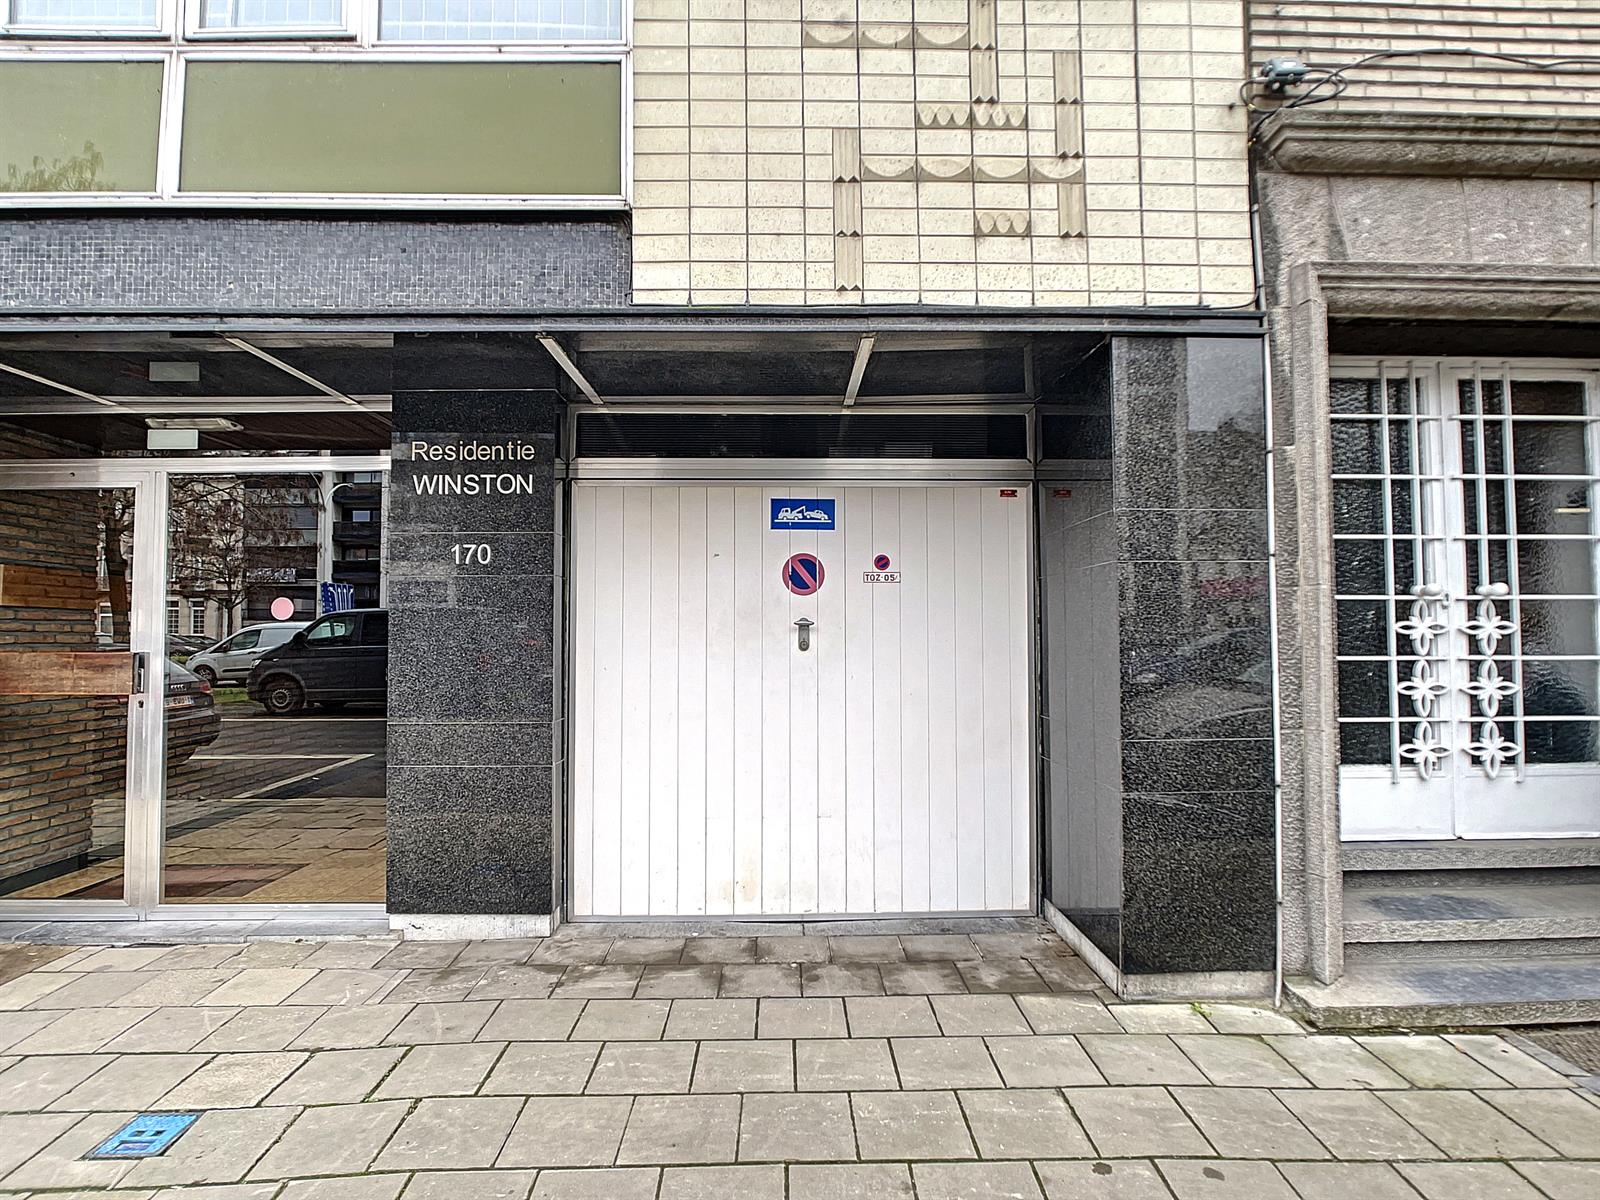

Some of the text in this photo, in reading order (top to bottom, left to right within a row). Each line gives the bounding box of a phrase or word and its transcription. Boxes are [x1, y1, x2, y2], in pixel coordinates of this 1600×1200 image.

[411, 441, 535, 461] Residentie
[412, 474, 533, 495] WINSTON
[450, 543, 491, 565] 170
